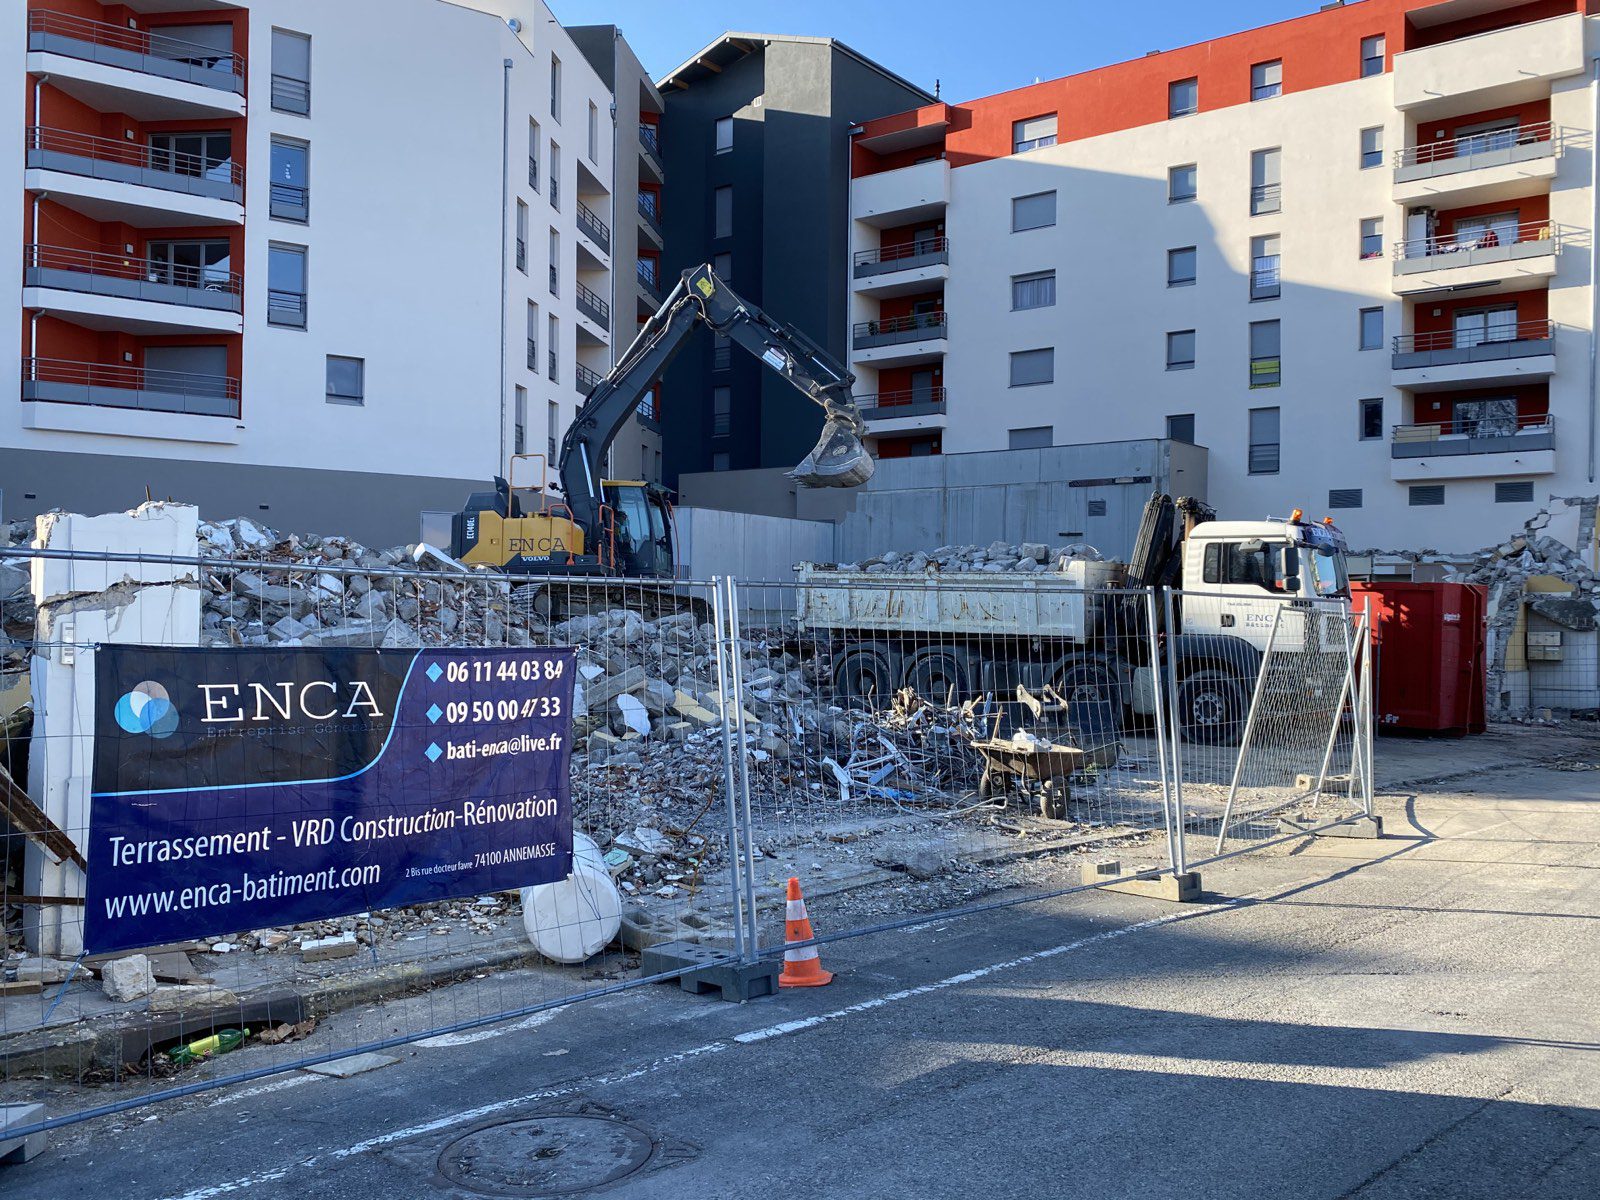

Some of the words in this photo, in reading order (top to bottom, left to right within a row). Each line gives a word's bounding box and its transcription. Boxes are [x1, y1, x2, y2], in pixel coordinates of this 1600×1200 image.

[509, 538, 565, 551] ENCA
[447, 661, 469, 683] 06
[473, 661, 492, 682] 11
[496, 660, 518, 681] 44
[521, 660, 540, 681] 03
[543, 660, 564, 680] 84
[197, 681, 384, 722] ENCA
[446, 701, 469, 723] 09
[472, 701, 494, 722] 50
[497, 699, 518, 721] 00
[520, 698, 539, 718] 47
[540, 696, 561, 717] 33
[207, 724, 305, 738] Entreprise
[447, 732, 562, 760] bati-enca@live.fr
[109, 826, 272, 867] Terrassement
[292, 818, 335, 848] VRD
[340, 795, 558, 842] Construction-Rénovation
[405, 868, 410, 878] 2
[411, 867, 421, 877] Bis
[421, 867, 433, 876] rue
[434, 863, 457, 874] docteur
[475, 851, 501, 868] 74100
[502, 842, 556, 864] ANNEMASSE
[105, 863, 381, 919] www.enca-batiment.com
